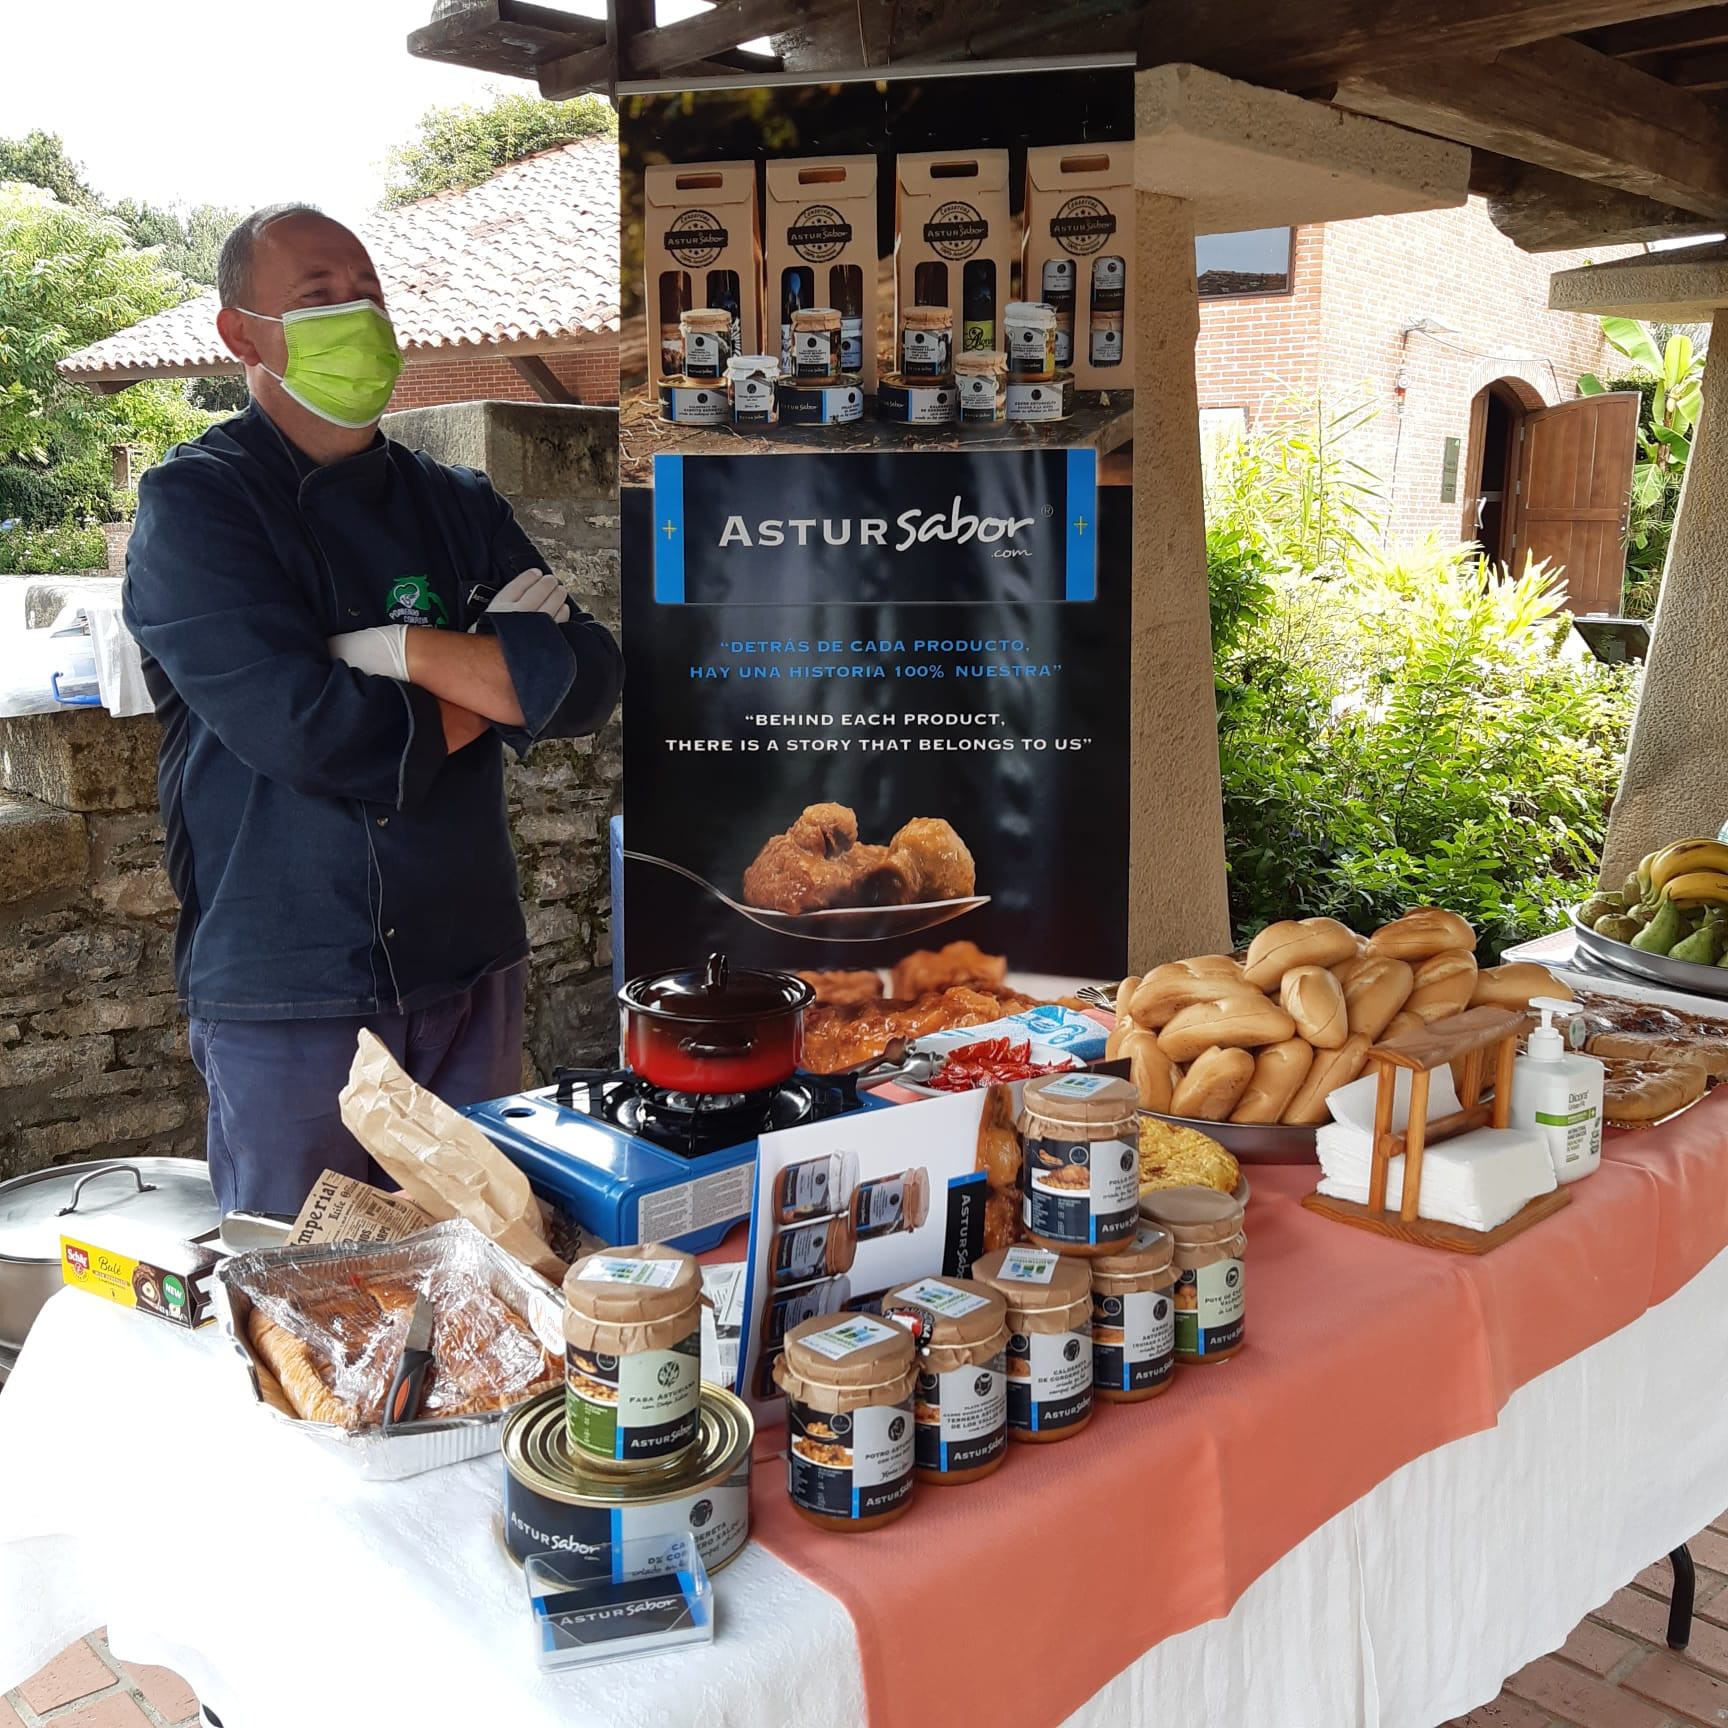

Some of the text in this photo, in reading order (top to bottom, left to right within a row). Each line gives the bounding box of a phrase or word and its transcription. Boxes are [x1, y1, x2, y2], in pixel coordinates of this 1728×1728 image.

[817, 640, 843, 653] DE
[850, 640, 906, 653] CADA
[690, 664, 1062, 679] HAY UNA HISTORIA 100% NUESTRA”
[745, 713, 1006, 728] “BEHIND EACH PRODUCT,
[665, 738, 1093, 752] THERE IS A STORY THAT BELONGS TO US”
[164, 1282, 182, 1300] NEW
[511, 1511, 601, 1554] ASTURSabor
[560, 1599, 677, 1627] ASTURSabor
